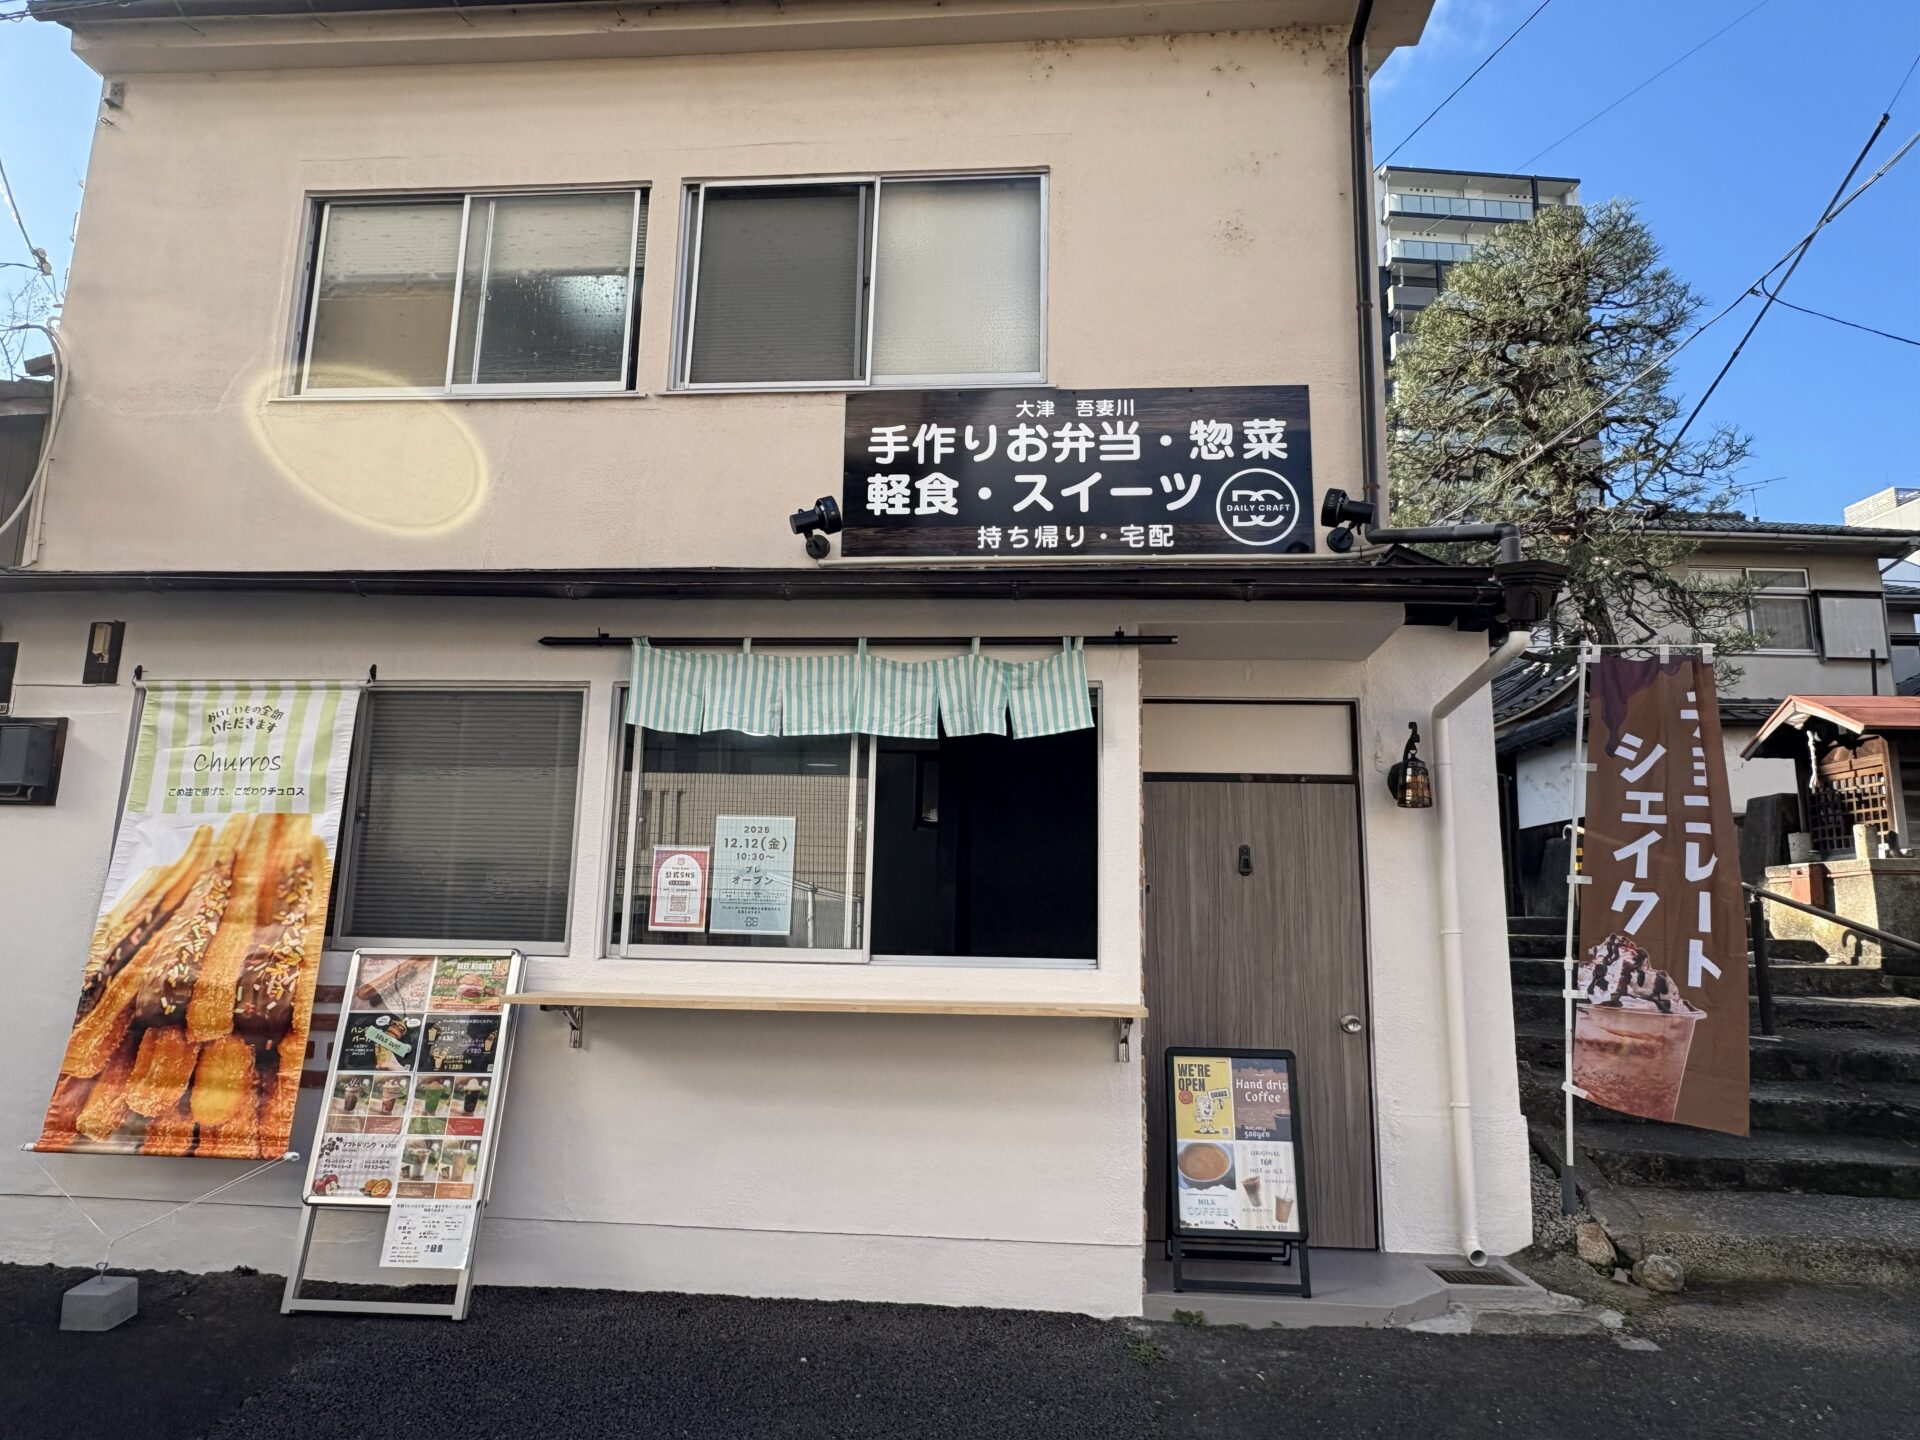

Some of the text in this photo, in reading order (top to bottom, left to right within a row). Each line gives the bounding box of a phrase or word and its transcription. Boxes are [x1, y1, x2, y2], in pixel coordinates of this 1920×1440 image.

[1015, 399, 1135, 418] 大津 吾妻川
[867, 418, 1288, 465] 手作りお弁当・惣菜
[866, 471, 1202, 516] 軽食・スイーツ
[1226, 503, 1291, 512] DAILY CRAFT
[977, 524, 1175, 549] 持ち帰り・宅配
[207, 704, 285, 723] おいしいもの全部
[211, 716, 278, 735] いただきます
[193, 751, 282, 772] Churros
[1177, 1063, 1211, 1078] WE'RE
[1178, 1078, 1206, 1092] OPEN
[1235, 1078, 1289, 1092] Hand drip
[1245, 1091, 1281, 1103] Coffee
